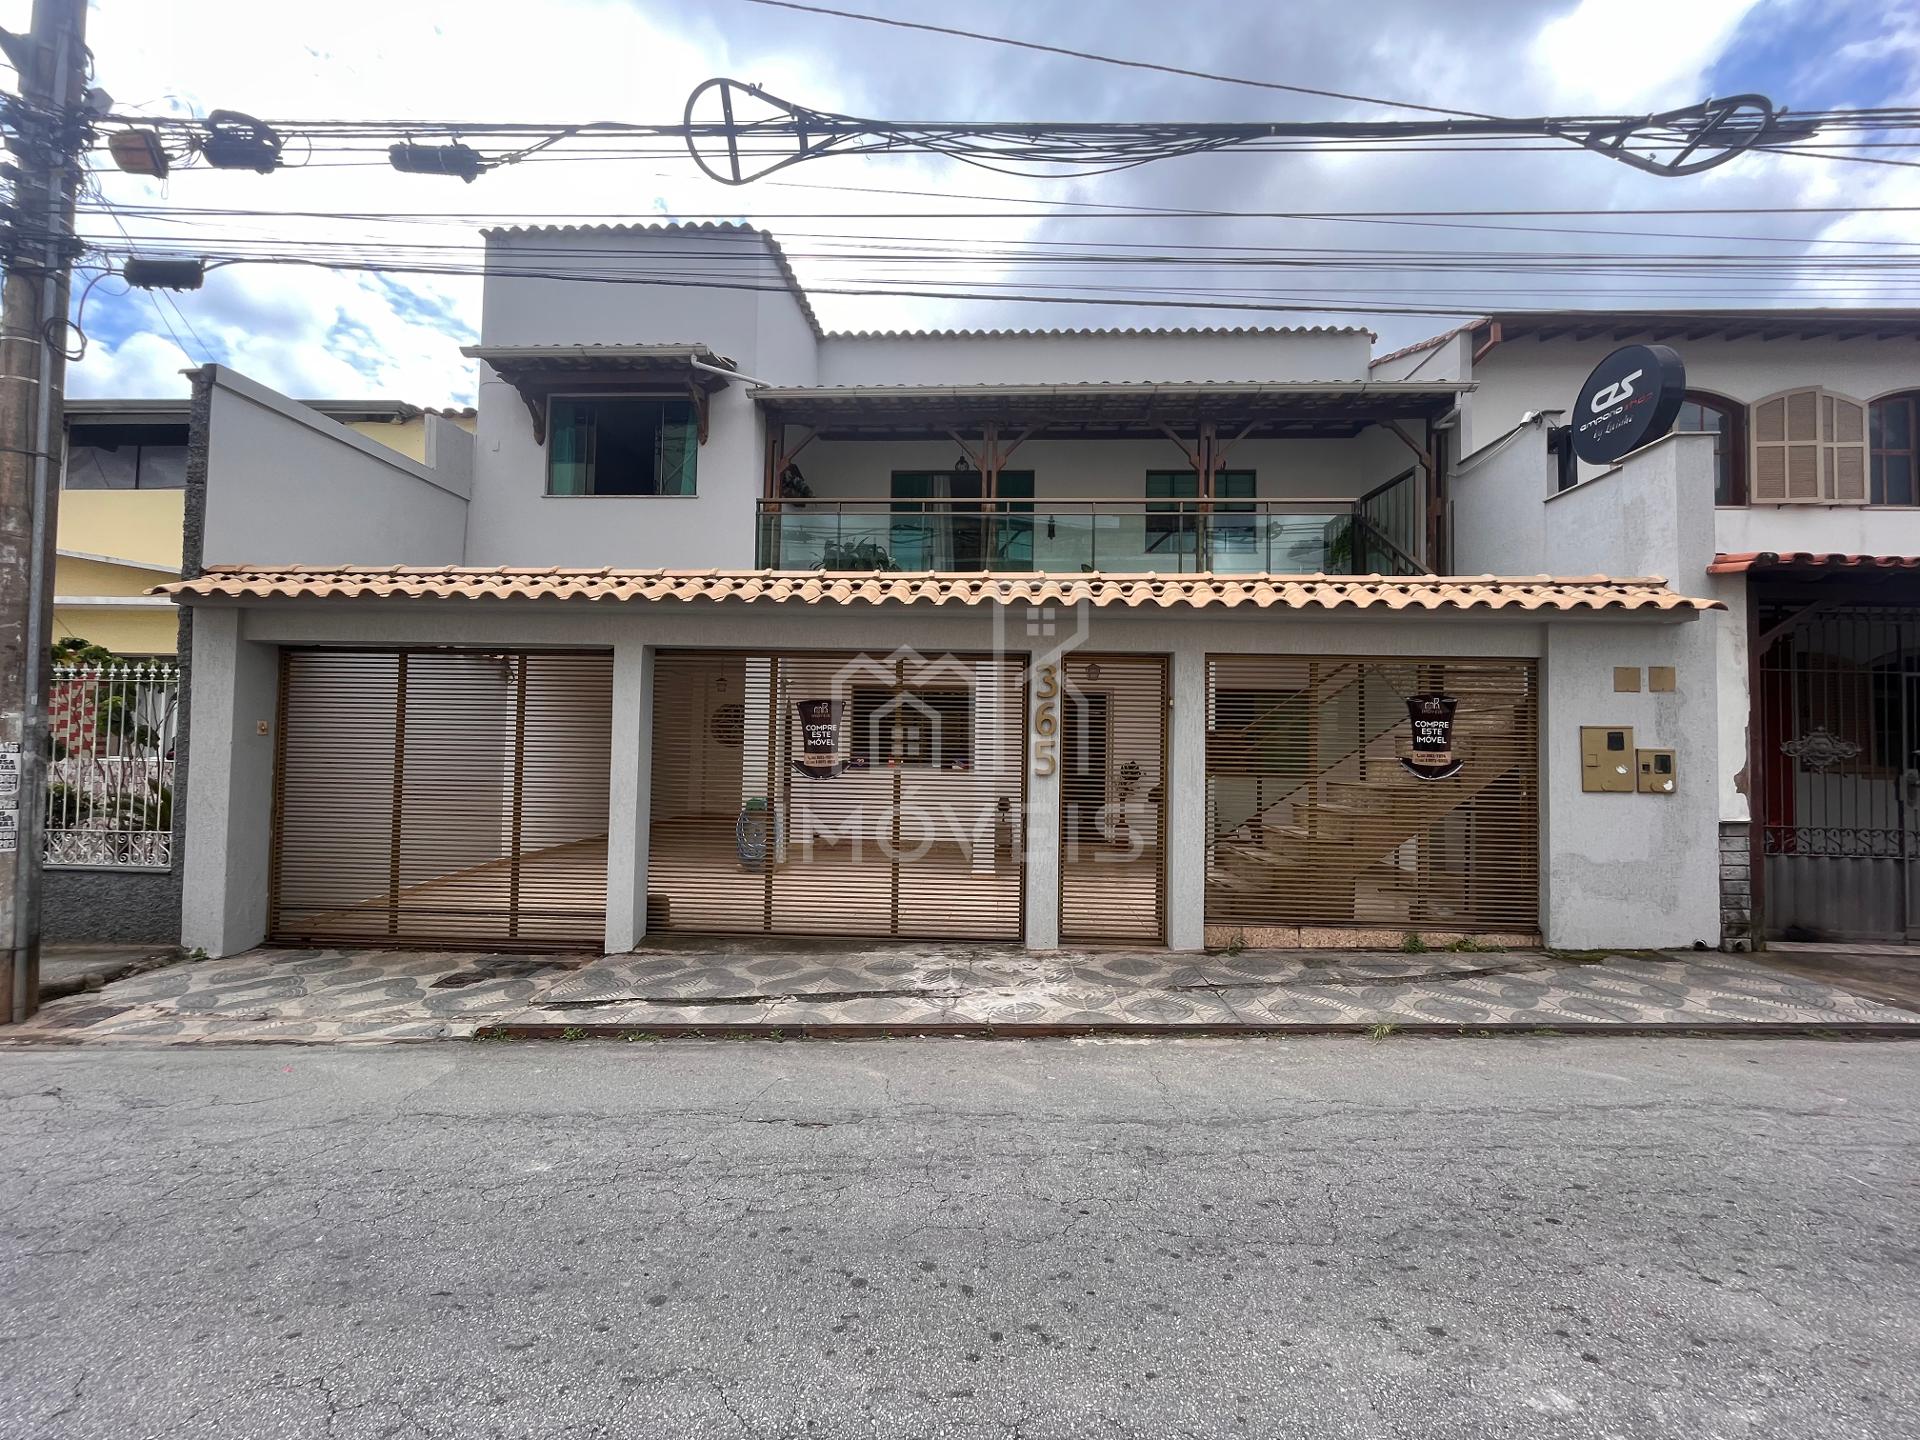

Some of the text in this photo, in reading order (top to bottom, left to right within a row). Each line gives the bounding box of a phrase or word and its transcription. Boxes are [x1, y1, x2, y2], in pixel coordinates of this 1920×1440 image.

[1034, 663, 1058, 777] 365
[1414, 720, 1449, 728] COMPRE
[807, 738, 835, 746] IMÓVEL
[1416, 735, 1447, 744] IMÓVEL
